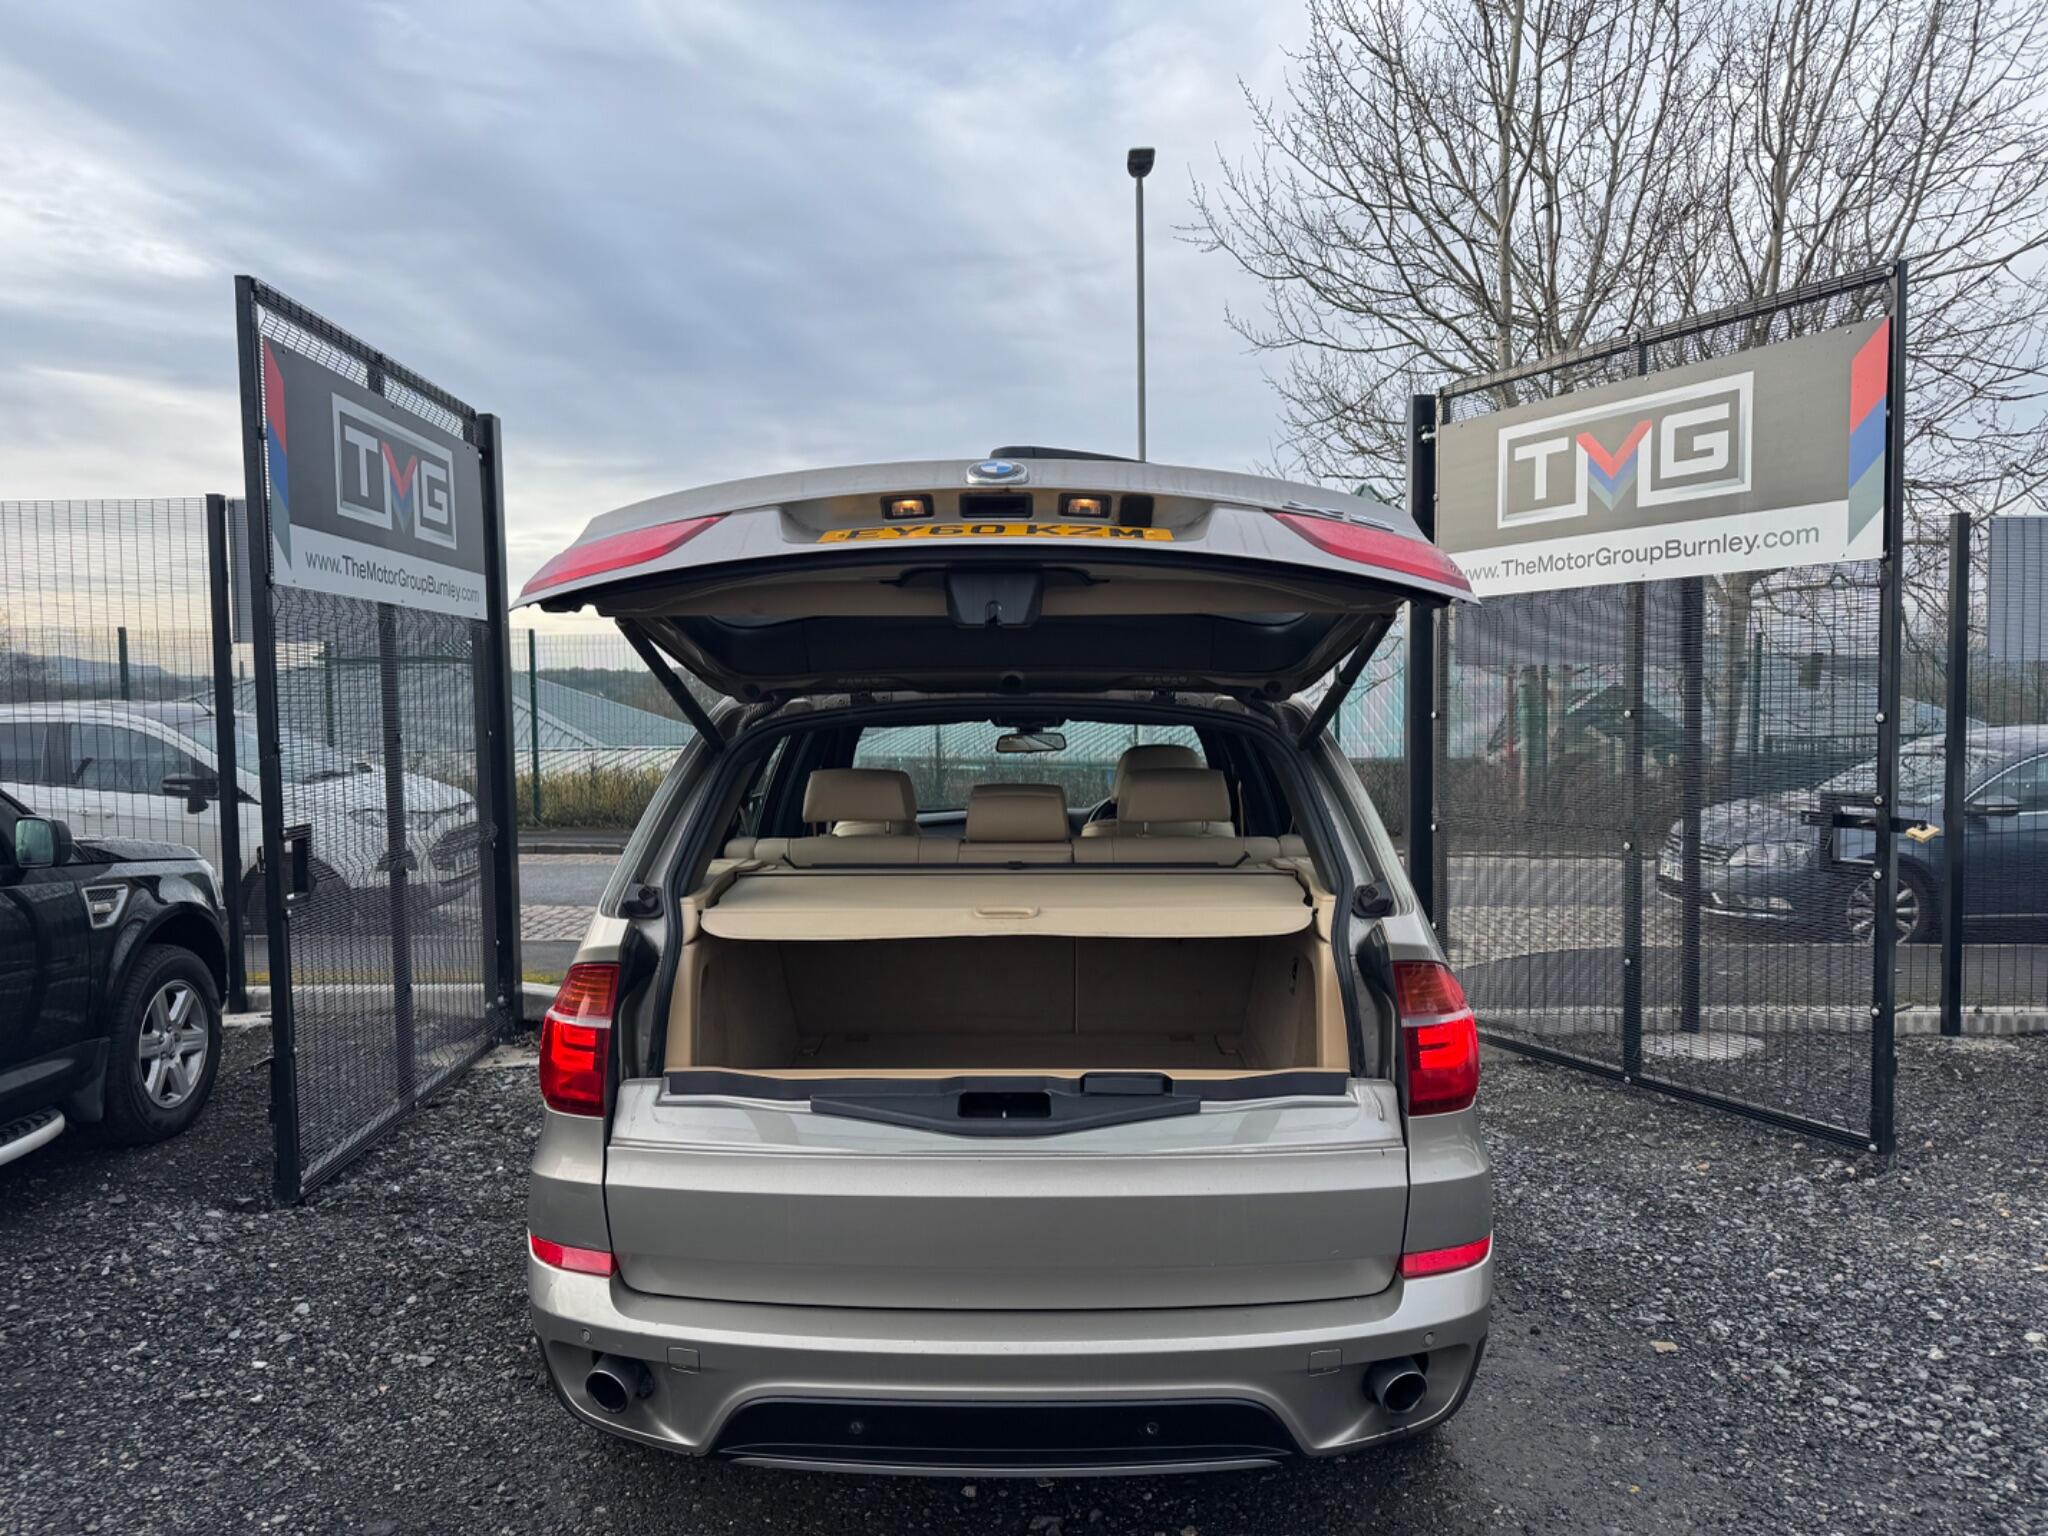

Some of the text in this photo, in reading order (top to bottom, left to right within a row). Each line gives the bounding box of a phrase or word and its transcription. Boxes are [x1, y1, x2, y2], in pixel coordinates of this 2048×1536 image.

[344, 425, 449, 537] TMG
[1514, 402, 1730, 515] TMG
[305, 551, 480, 602] www.TheMotorGroupBurnley.com
[1465, 526, 1819, 580] ww.TheMotorGroupBurnley.com
